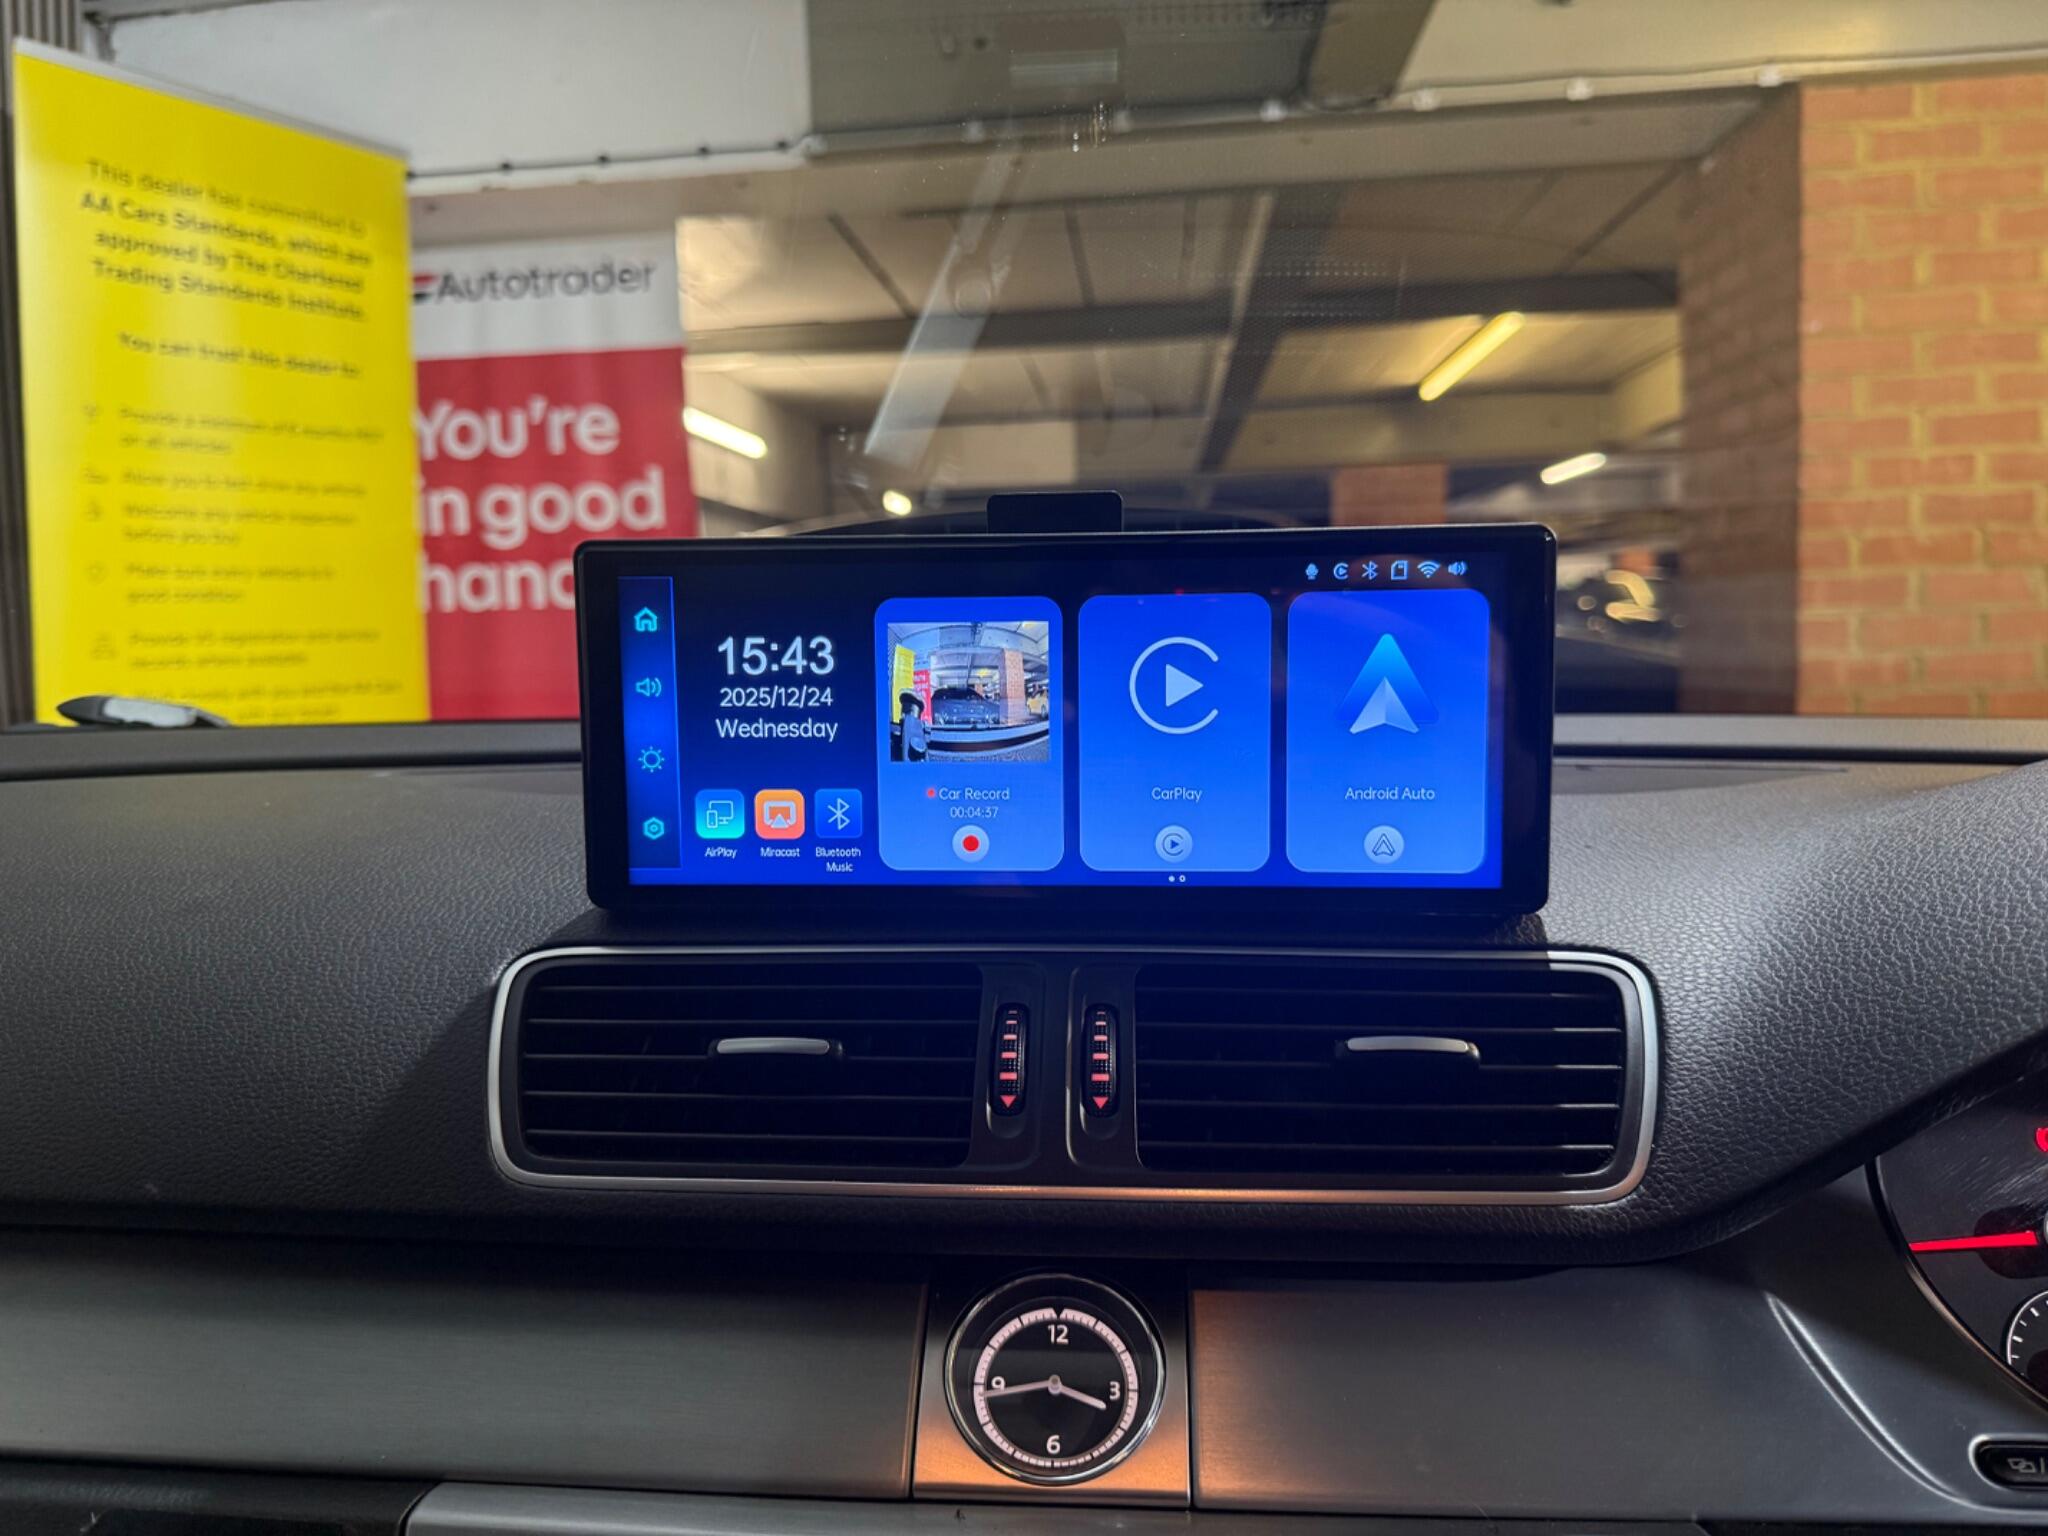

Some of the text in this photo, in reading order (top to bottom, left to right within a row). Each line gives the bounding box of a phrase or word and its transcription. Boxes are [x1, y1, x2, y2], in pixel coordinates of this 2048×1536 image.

[88, 160, 132, 186] This
[139, 174, 203, 198] dealer
[80, 191, 111, 214] AA
[117, 198, 167, 226] Cars
[95, 233, 197, 263] approved
[202, 245, 227, 272] by
[234, 252, 267, 274] The
[93, 258, 174, 292] Trading
[180, 273, 282, 305] Standards
[437, 261, 655, 301] Autotrader
[411, 395, 620, 461] You're
[478, 463, 666, 550] good
[717, 635, 835, 676] 15:43
[719, 685, 834, 709] 2025/12/24
[715, 717, 839, 743] Wednesday
[939, 786, 1011, 801] Car Record
[1151, 786, 1203, 803] CarPlay
[1344, 786, 1436, 801] Android Auto
[949, 806, 999, 819] 00:04:37
[704, 846, 738, 860] AirPlay
[759, 846, 801, 858] Miracast
[815, 846, 862, 858] Bluetooth
[825, 861, 854, 873] Music
[1047, 1324, 1070, 1345] 12
[1109, 1380, 1122, 1401] 3
[1046, 1434, 1061, 1455] 6
